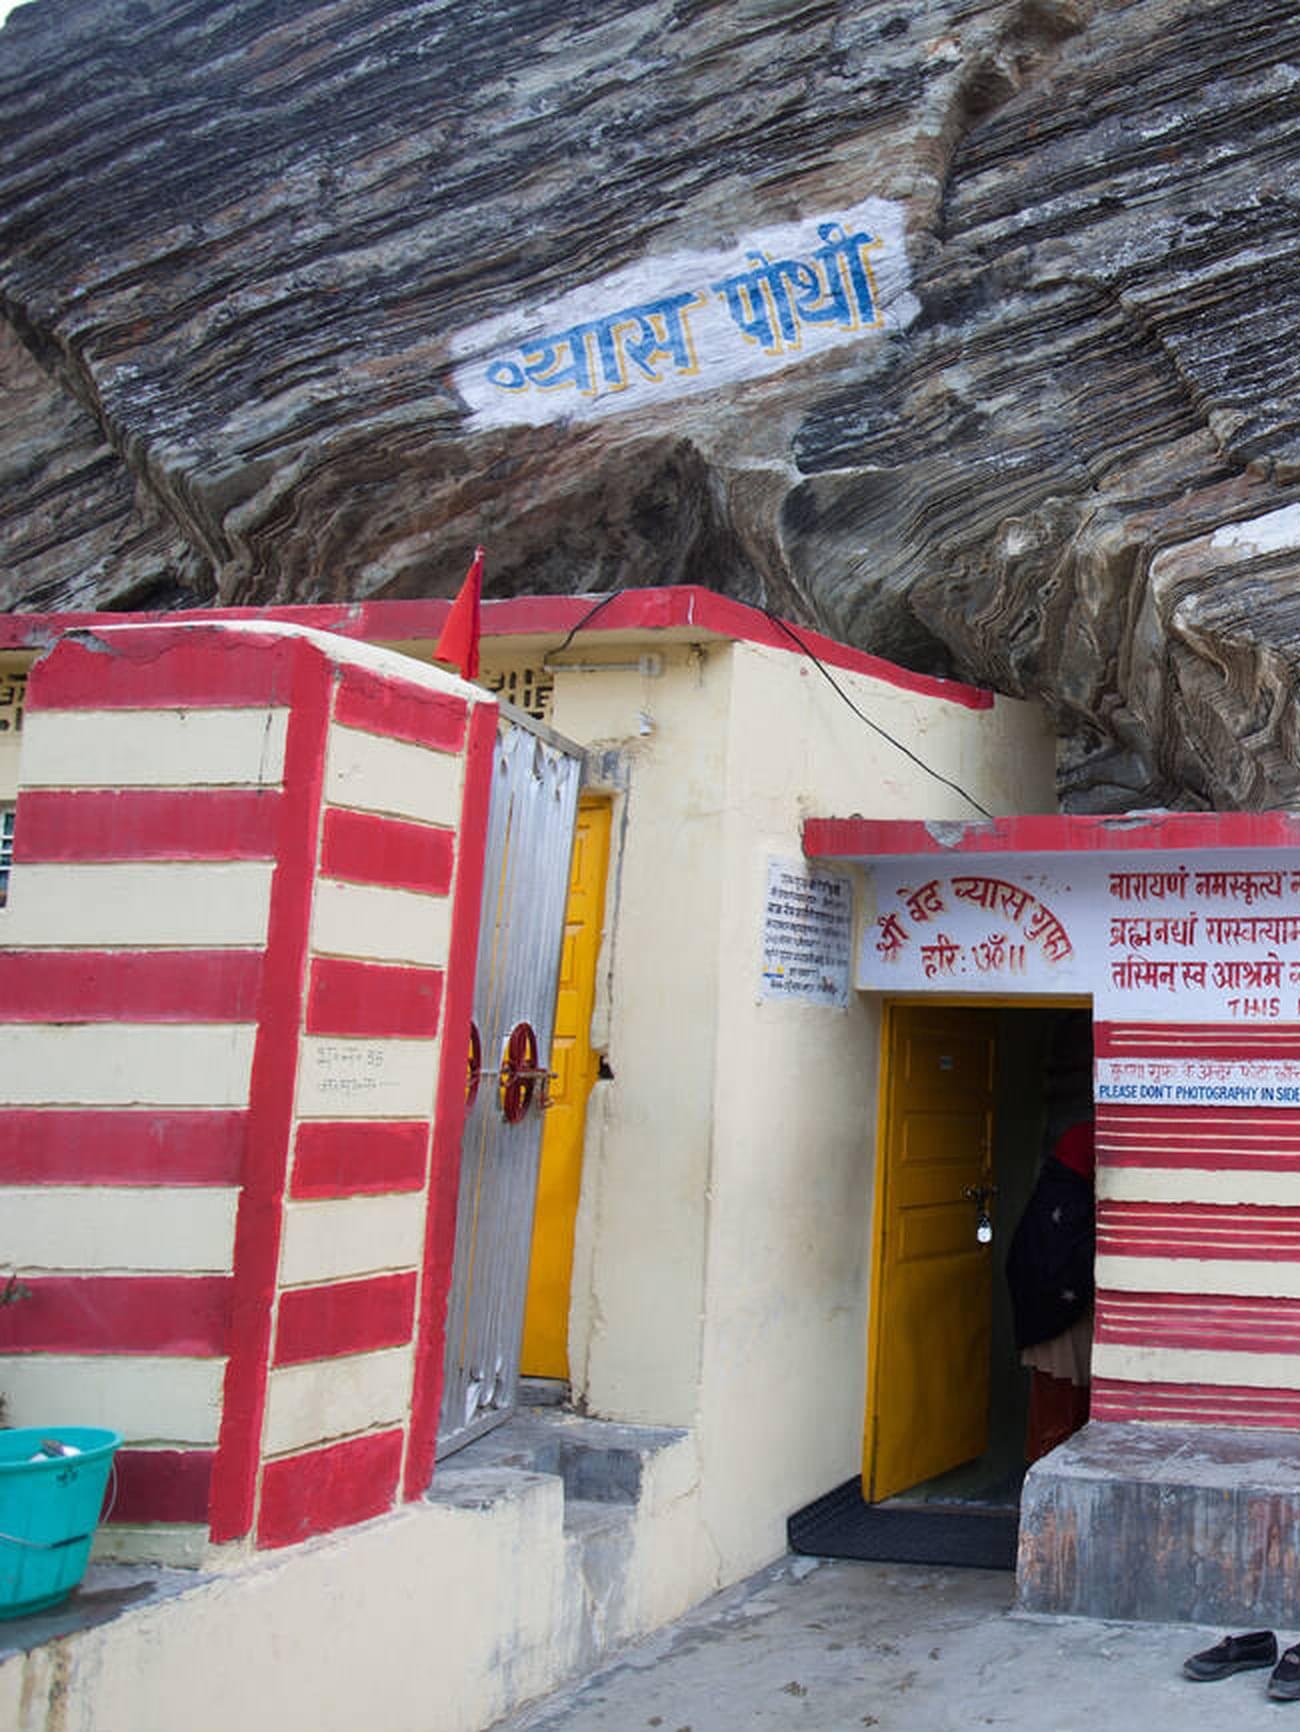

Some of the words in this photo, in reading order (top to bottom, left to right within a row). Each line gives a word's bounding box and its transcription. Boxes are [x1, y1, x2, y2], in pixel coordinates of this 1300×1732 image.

[485, 292, 706, 396] व्यास
[711, 222, 883, 355] पोथी
[1109, 864, 1190, 901] नारायणं
[1195, 870, 1286, 905] नमस्कृत्य
[876, 911, 909, 962] श्री
[896, 879, 944, 923] वेद
[950, 876, 1036, 921] व्यास
[1023, 902, 1074, 963] गुफा
[1228, 997, 1281, 1017] THIS
[1099, 1085, 1138, 1099] PLEASE
[1140, 1085, 1173, 1099] DON'T
[1175, 1086, 1258, 1100] PHOTOGRAPHY
[1260, 1087, 1275, 1100] IN
[1276, 1087, 1300, 1101] SIDE
